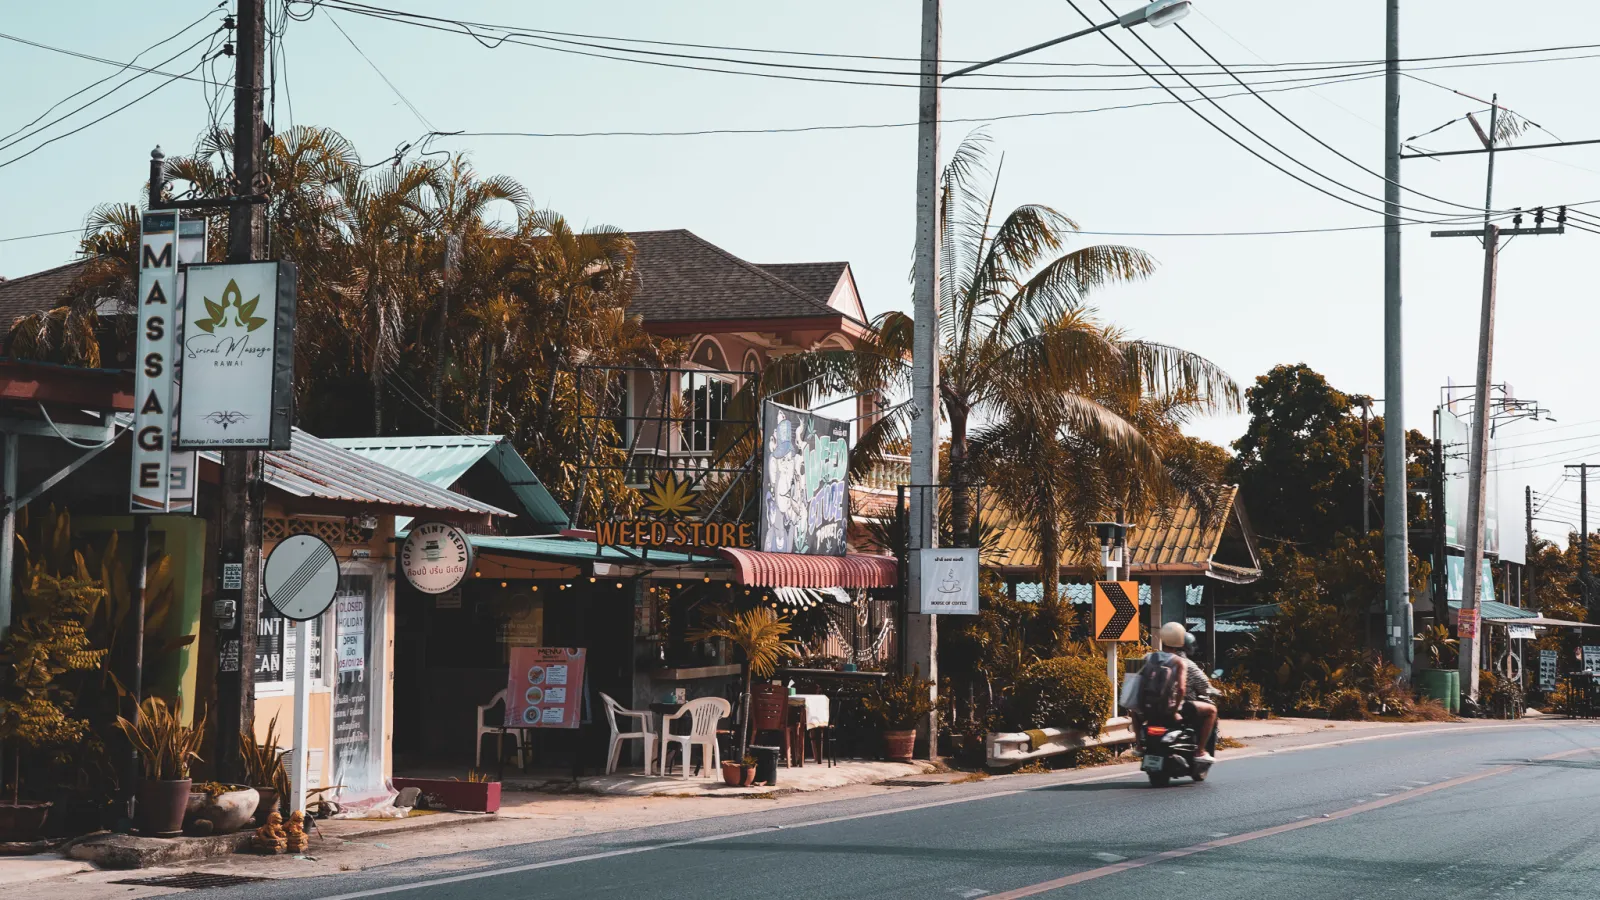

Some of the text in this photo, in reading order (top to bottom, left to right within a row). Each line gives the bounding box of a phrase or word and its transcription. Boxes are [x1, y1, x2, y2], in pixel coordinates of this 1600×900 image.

[217, 334, 271, 358] Massage
[137, 242, 173, 490] MASSAGE
[214, 360, 243, 368] RAWAI
[804, 434, 847, 503] WEED
[808, 482, 844, 535] STORE
[402, 525, 466, 566] COPY PRINT MEDIA
[594, 520, 754, 548] WEED STORE
[343, 635, 358, 645] OPEN
[537, 648, 562, 656] MENU
